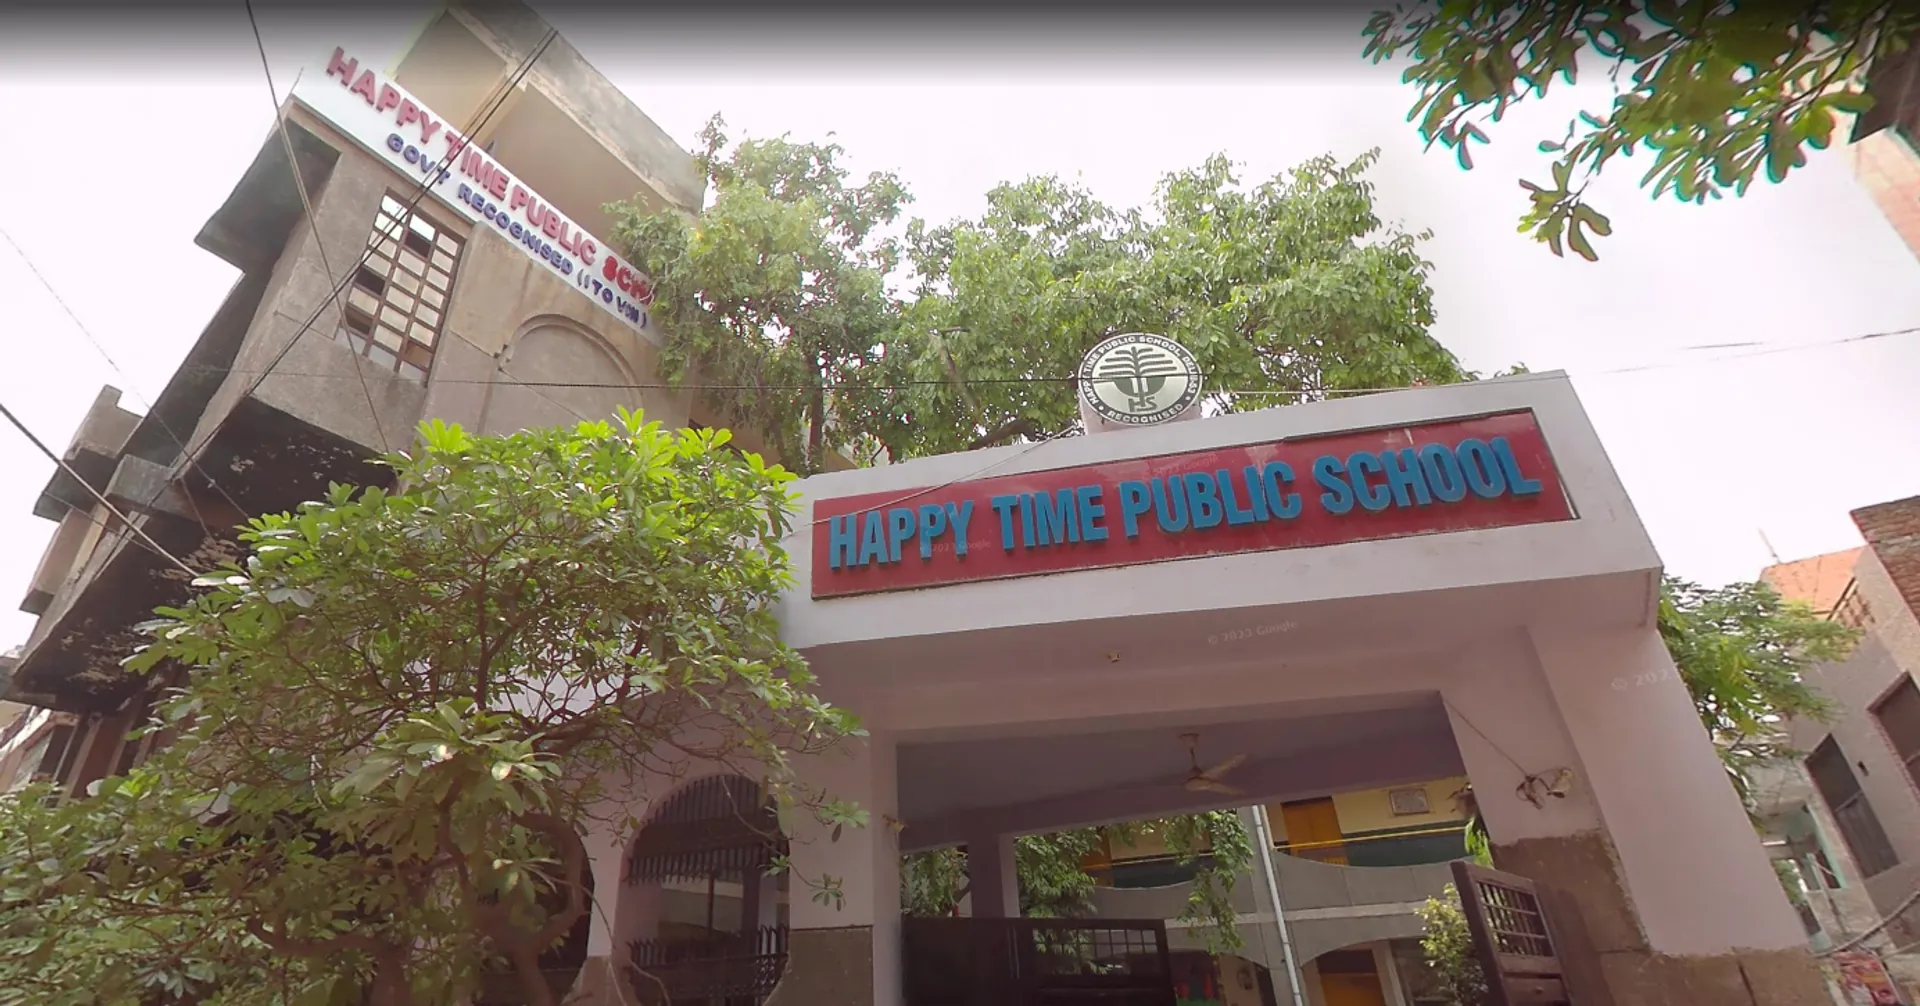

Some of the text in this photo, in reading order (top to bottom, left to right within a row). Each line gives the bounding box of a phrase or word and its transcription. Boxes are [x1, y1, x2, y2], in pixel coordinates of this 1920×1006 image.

[326, 46, 441, 144] HAPPY
[445, 130, 510, 202] TIME
[510, 184, 596, 266] PUBLIC
[458, 183, 573, 275] RECOGNISED
[592, 279, 613, 304] TO
[1083, 353, 1100, 372] TIME
[1098, 336, 1136, 354] PUBLIC
[1107, 403, 1184, 423] RECOGNISED
[829, 438, 1542, 570] HAPPY TIME PUBLIC SCHOOL
